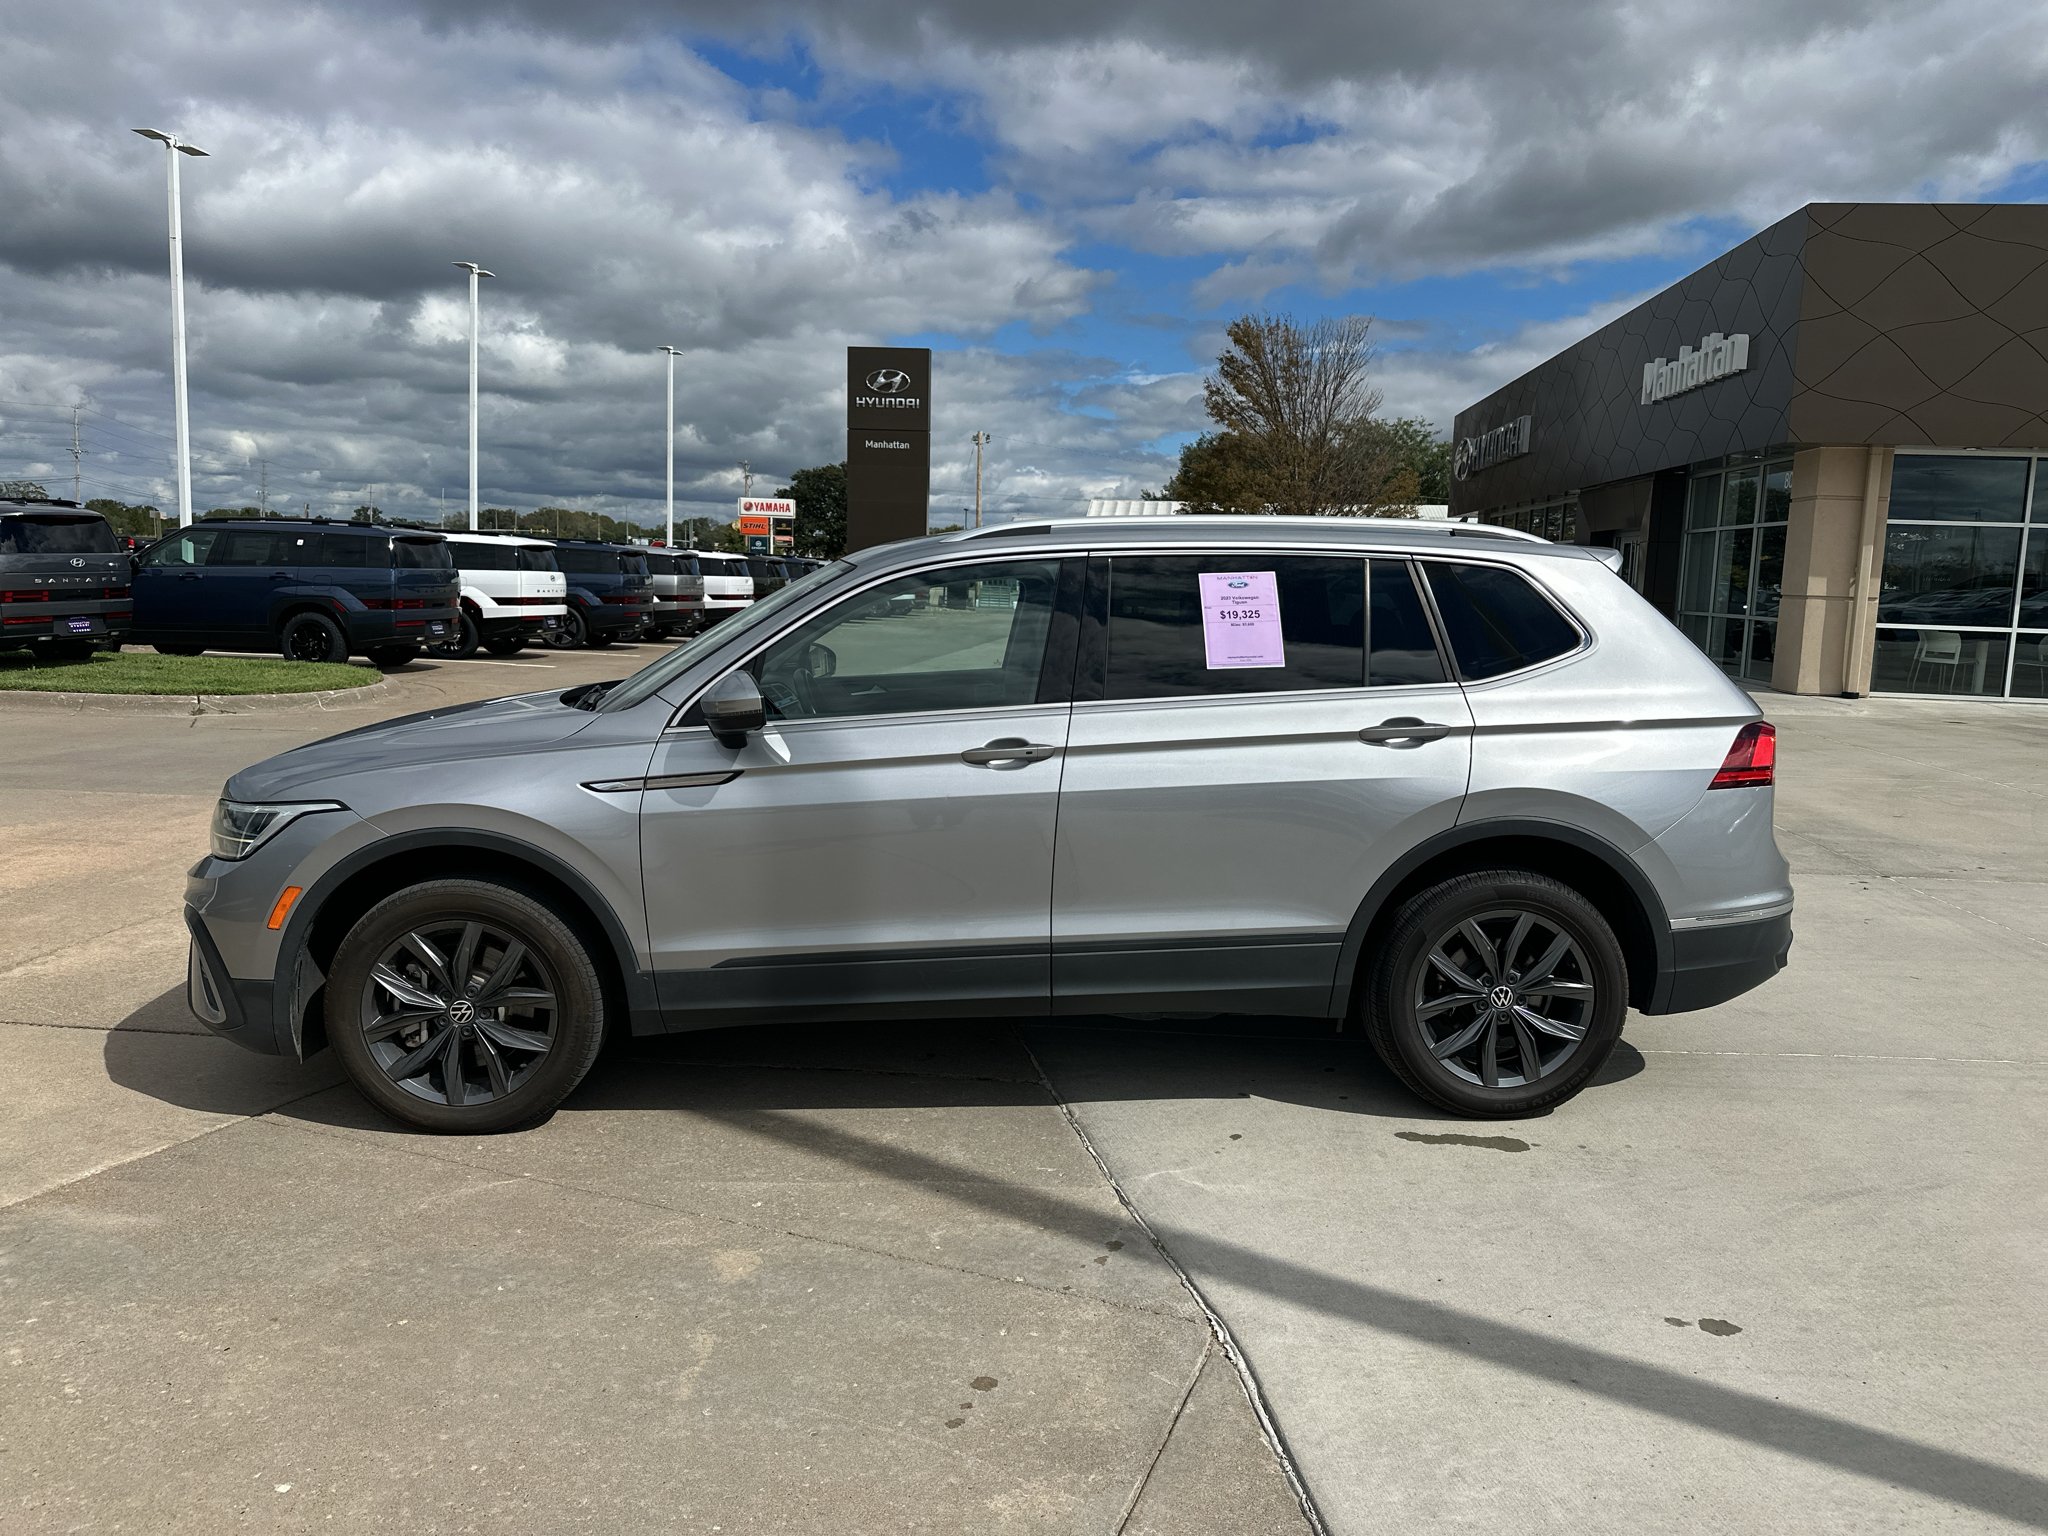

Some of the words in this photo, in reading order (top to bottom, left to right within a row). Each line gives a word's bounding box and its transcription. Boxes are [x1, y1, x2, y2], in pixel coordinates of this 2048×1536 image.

[1641, 332, 1750, 405] Manhattan
[856, 397, 920, 409] HYUNDAI
[865, 440, 910, 449] Manhattan
[754, 501, 791, 513] YAMAHA
[743, 522, 767, 530] STIHL
[1220, 609, 1261, 621] $19,325
